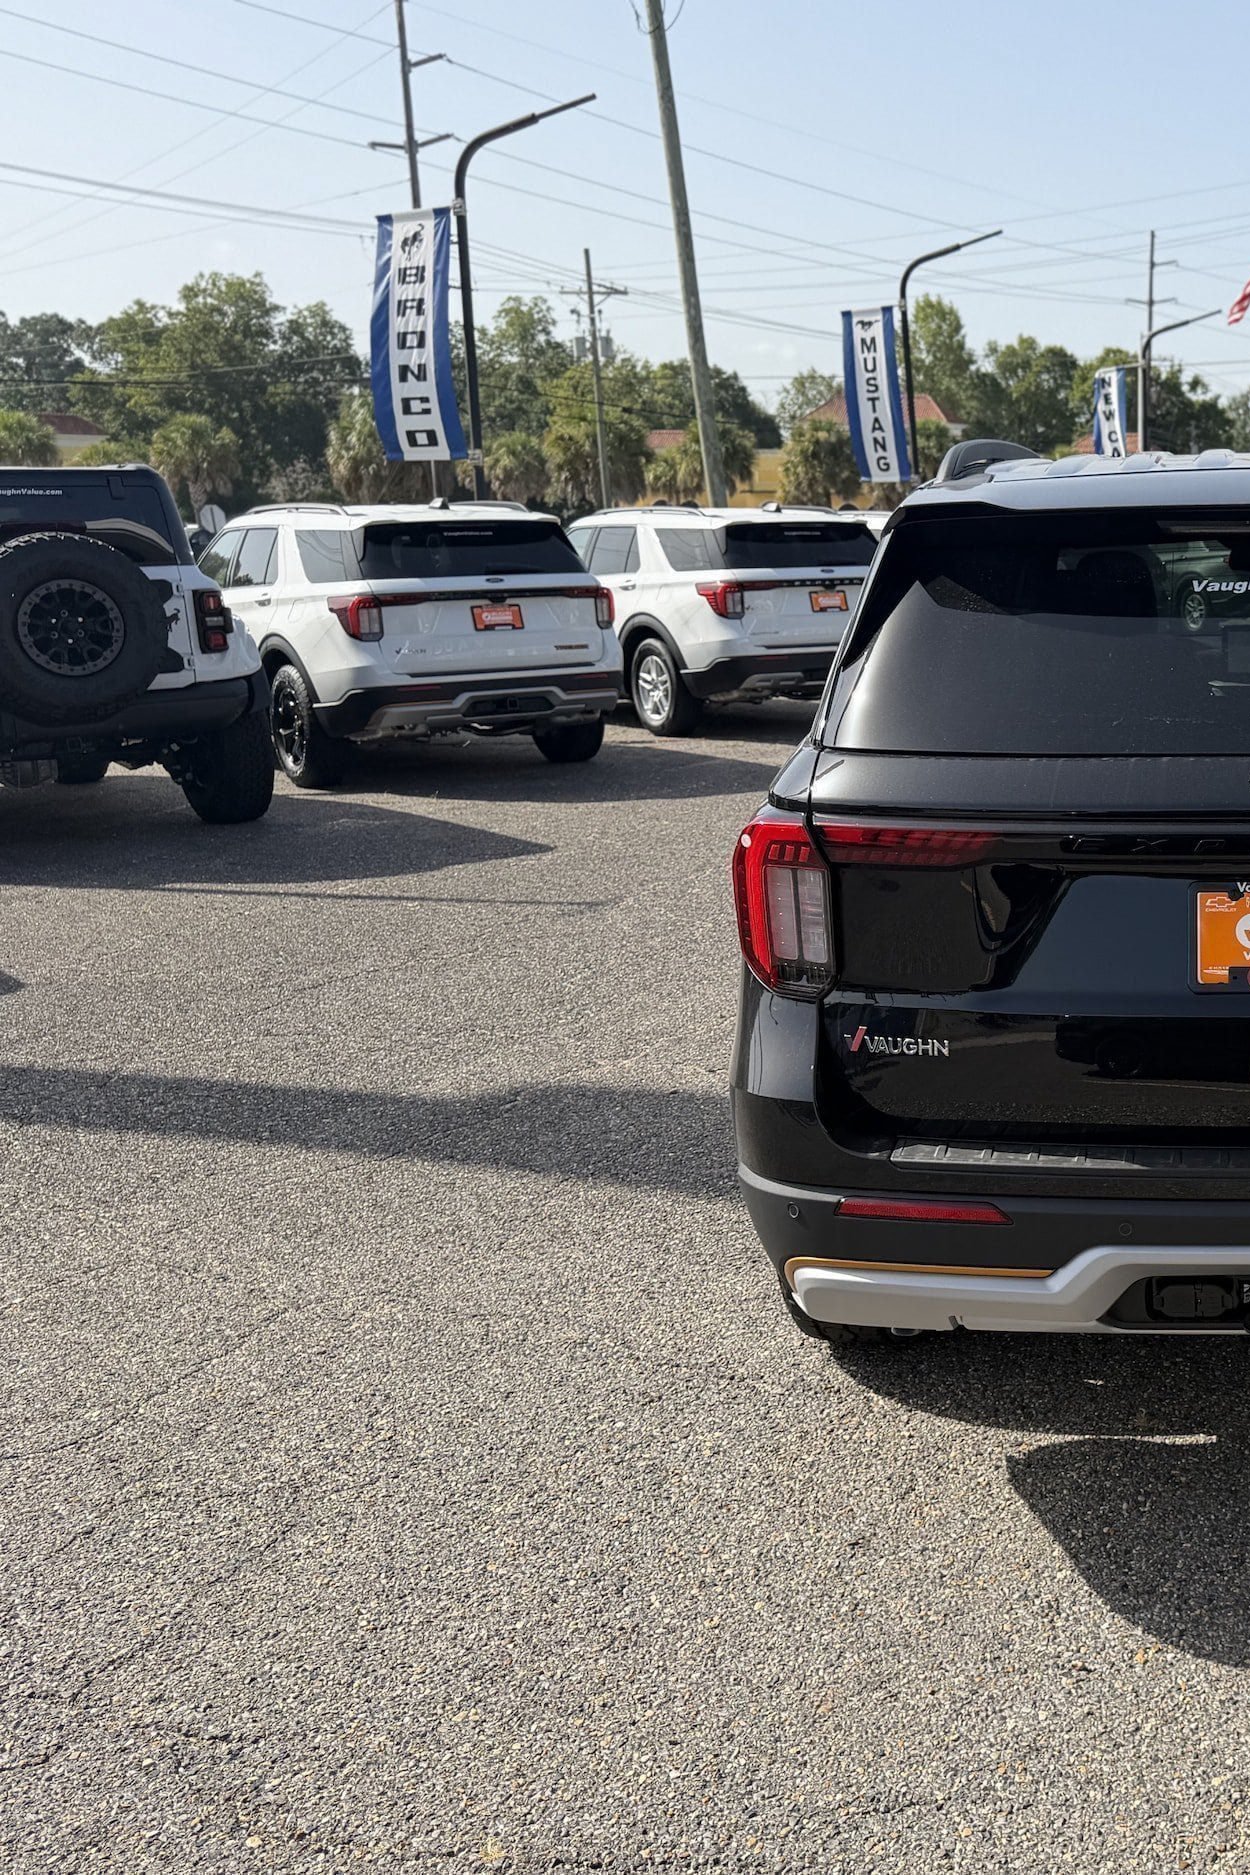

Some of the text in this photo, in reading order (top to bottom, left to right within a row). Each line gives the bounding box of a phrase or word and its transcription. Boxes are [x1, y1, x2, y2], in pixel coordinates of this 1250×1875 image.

[397, 265, 438, 448] BRONCO
[1101, 376, 1115, 422] NEW
[860, 336, 891, 472] MUSTANG
[863, 1035, 950, 1057] VAUGHN
